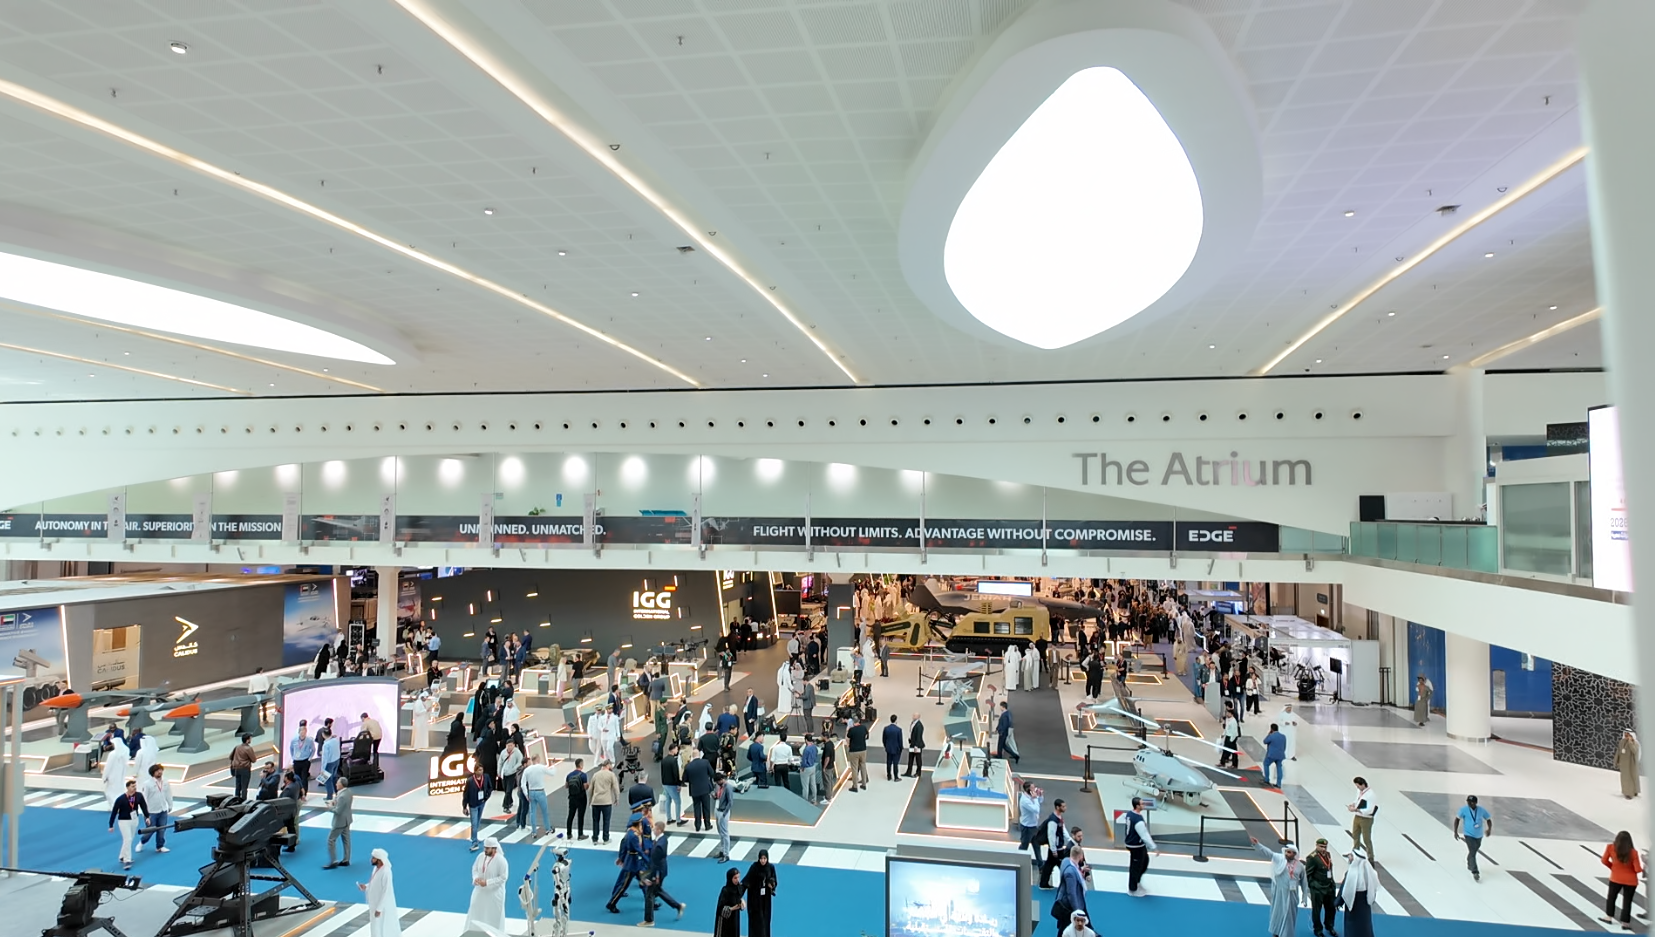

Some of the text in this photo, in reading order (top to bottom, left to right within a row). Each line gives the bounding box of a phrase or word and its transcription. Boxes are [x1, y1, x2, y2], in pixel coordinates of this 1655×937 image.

[1072, 451, 1313, 487] The Atrium
[35, 521, 90, 531] AUTONOMY
[91, 522, 101, 531] IN
[218, 522, 238, 532] THE
[753, 526, 795, 537] FLIGHT
[797, 526, 857, 538] WITHOUT
[859, 527, 902, 539] LIMITS.
[987, 528, 1052, 540] WITHOUT
[1054, 529, 1156, 541] COMPROMISE.
[1188, 530, 1234, 542] EDGE
[633, 591, 671, 609] IGG
